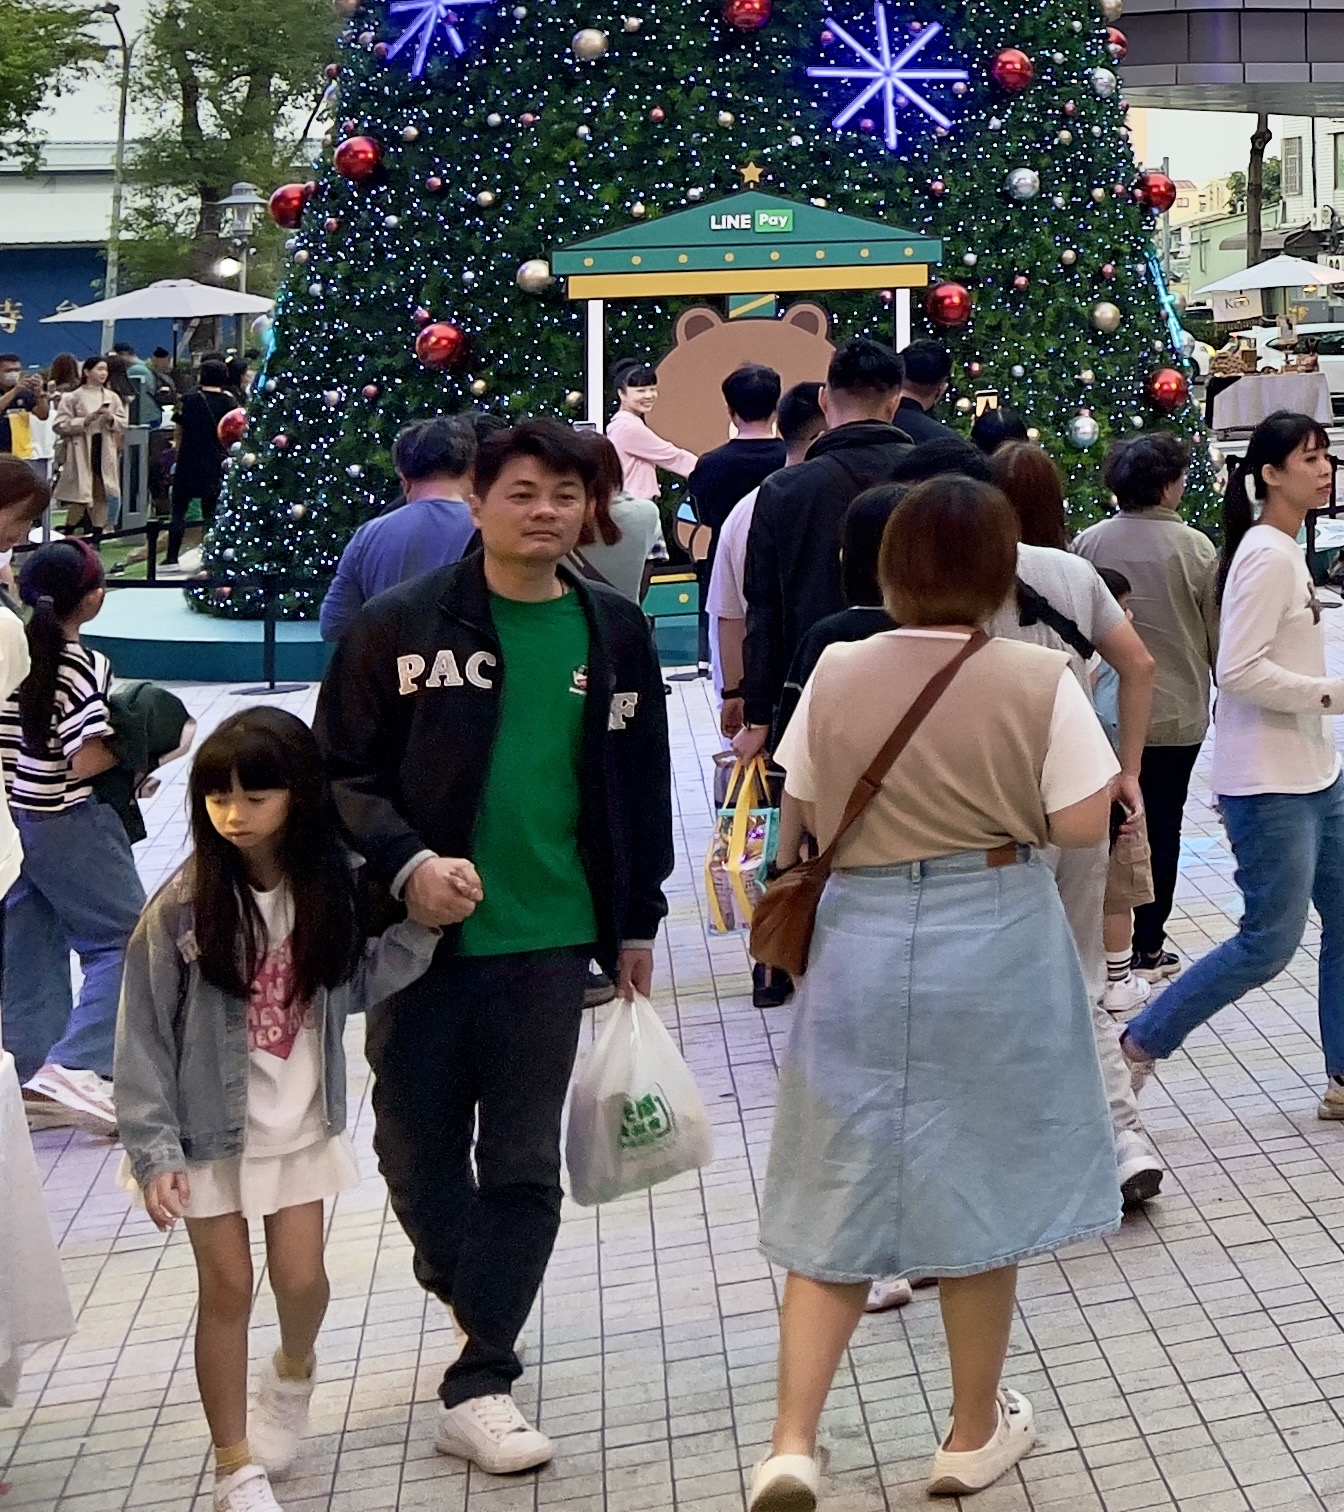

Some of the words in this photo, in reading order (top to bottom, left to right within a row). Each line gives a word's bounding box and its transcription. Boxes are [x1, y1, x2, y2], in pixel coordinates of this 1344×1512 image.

[710, 214, 751, 231] LINE
[759, 213, 789, 229] Pay
[397, 650, 497, 695] PAC
[607, 692, 639, 731] F
